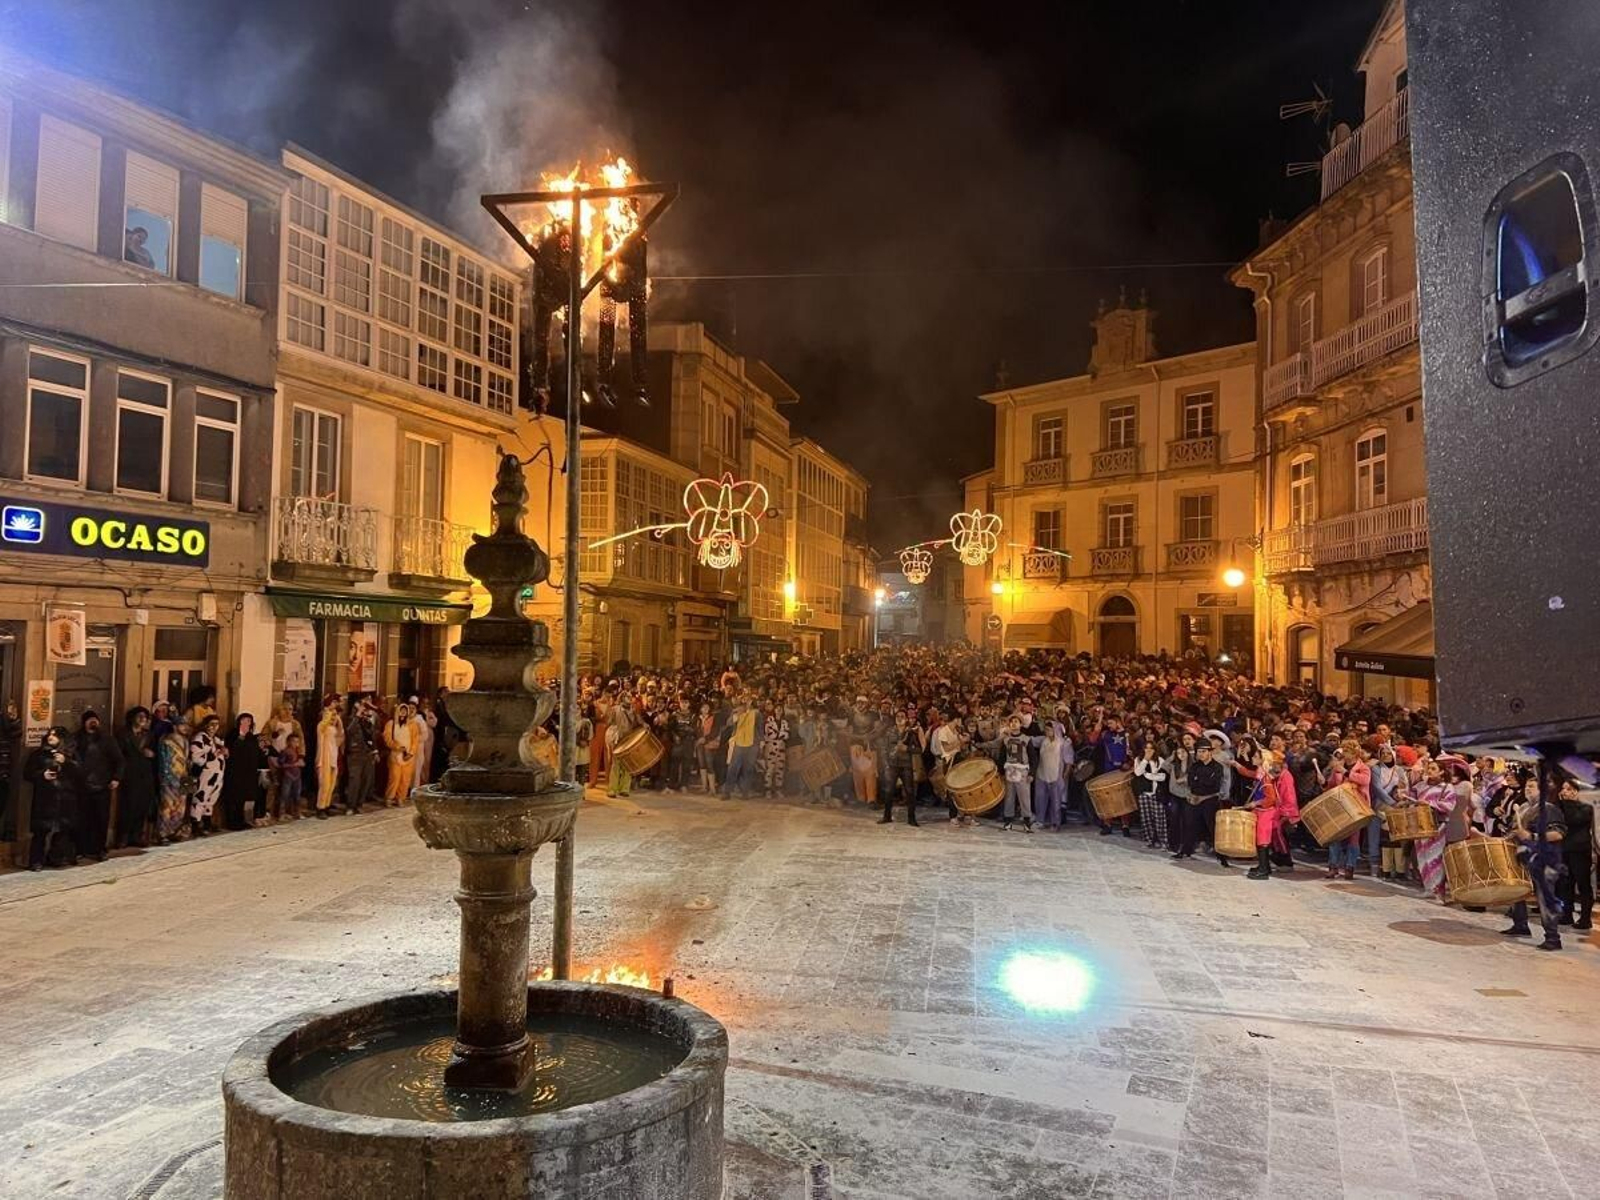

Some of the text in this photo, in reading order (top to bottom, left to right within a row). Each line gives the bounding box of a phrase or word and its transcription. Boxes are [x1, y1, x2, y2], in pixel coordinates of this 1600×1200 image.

[71, 517, 206, 556] OCASO
[309, 602, 448, 622] FARMACIA QUINTAS
